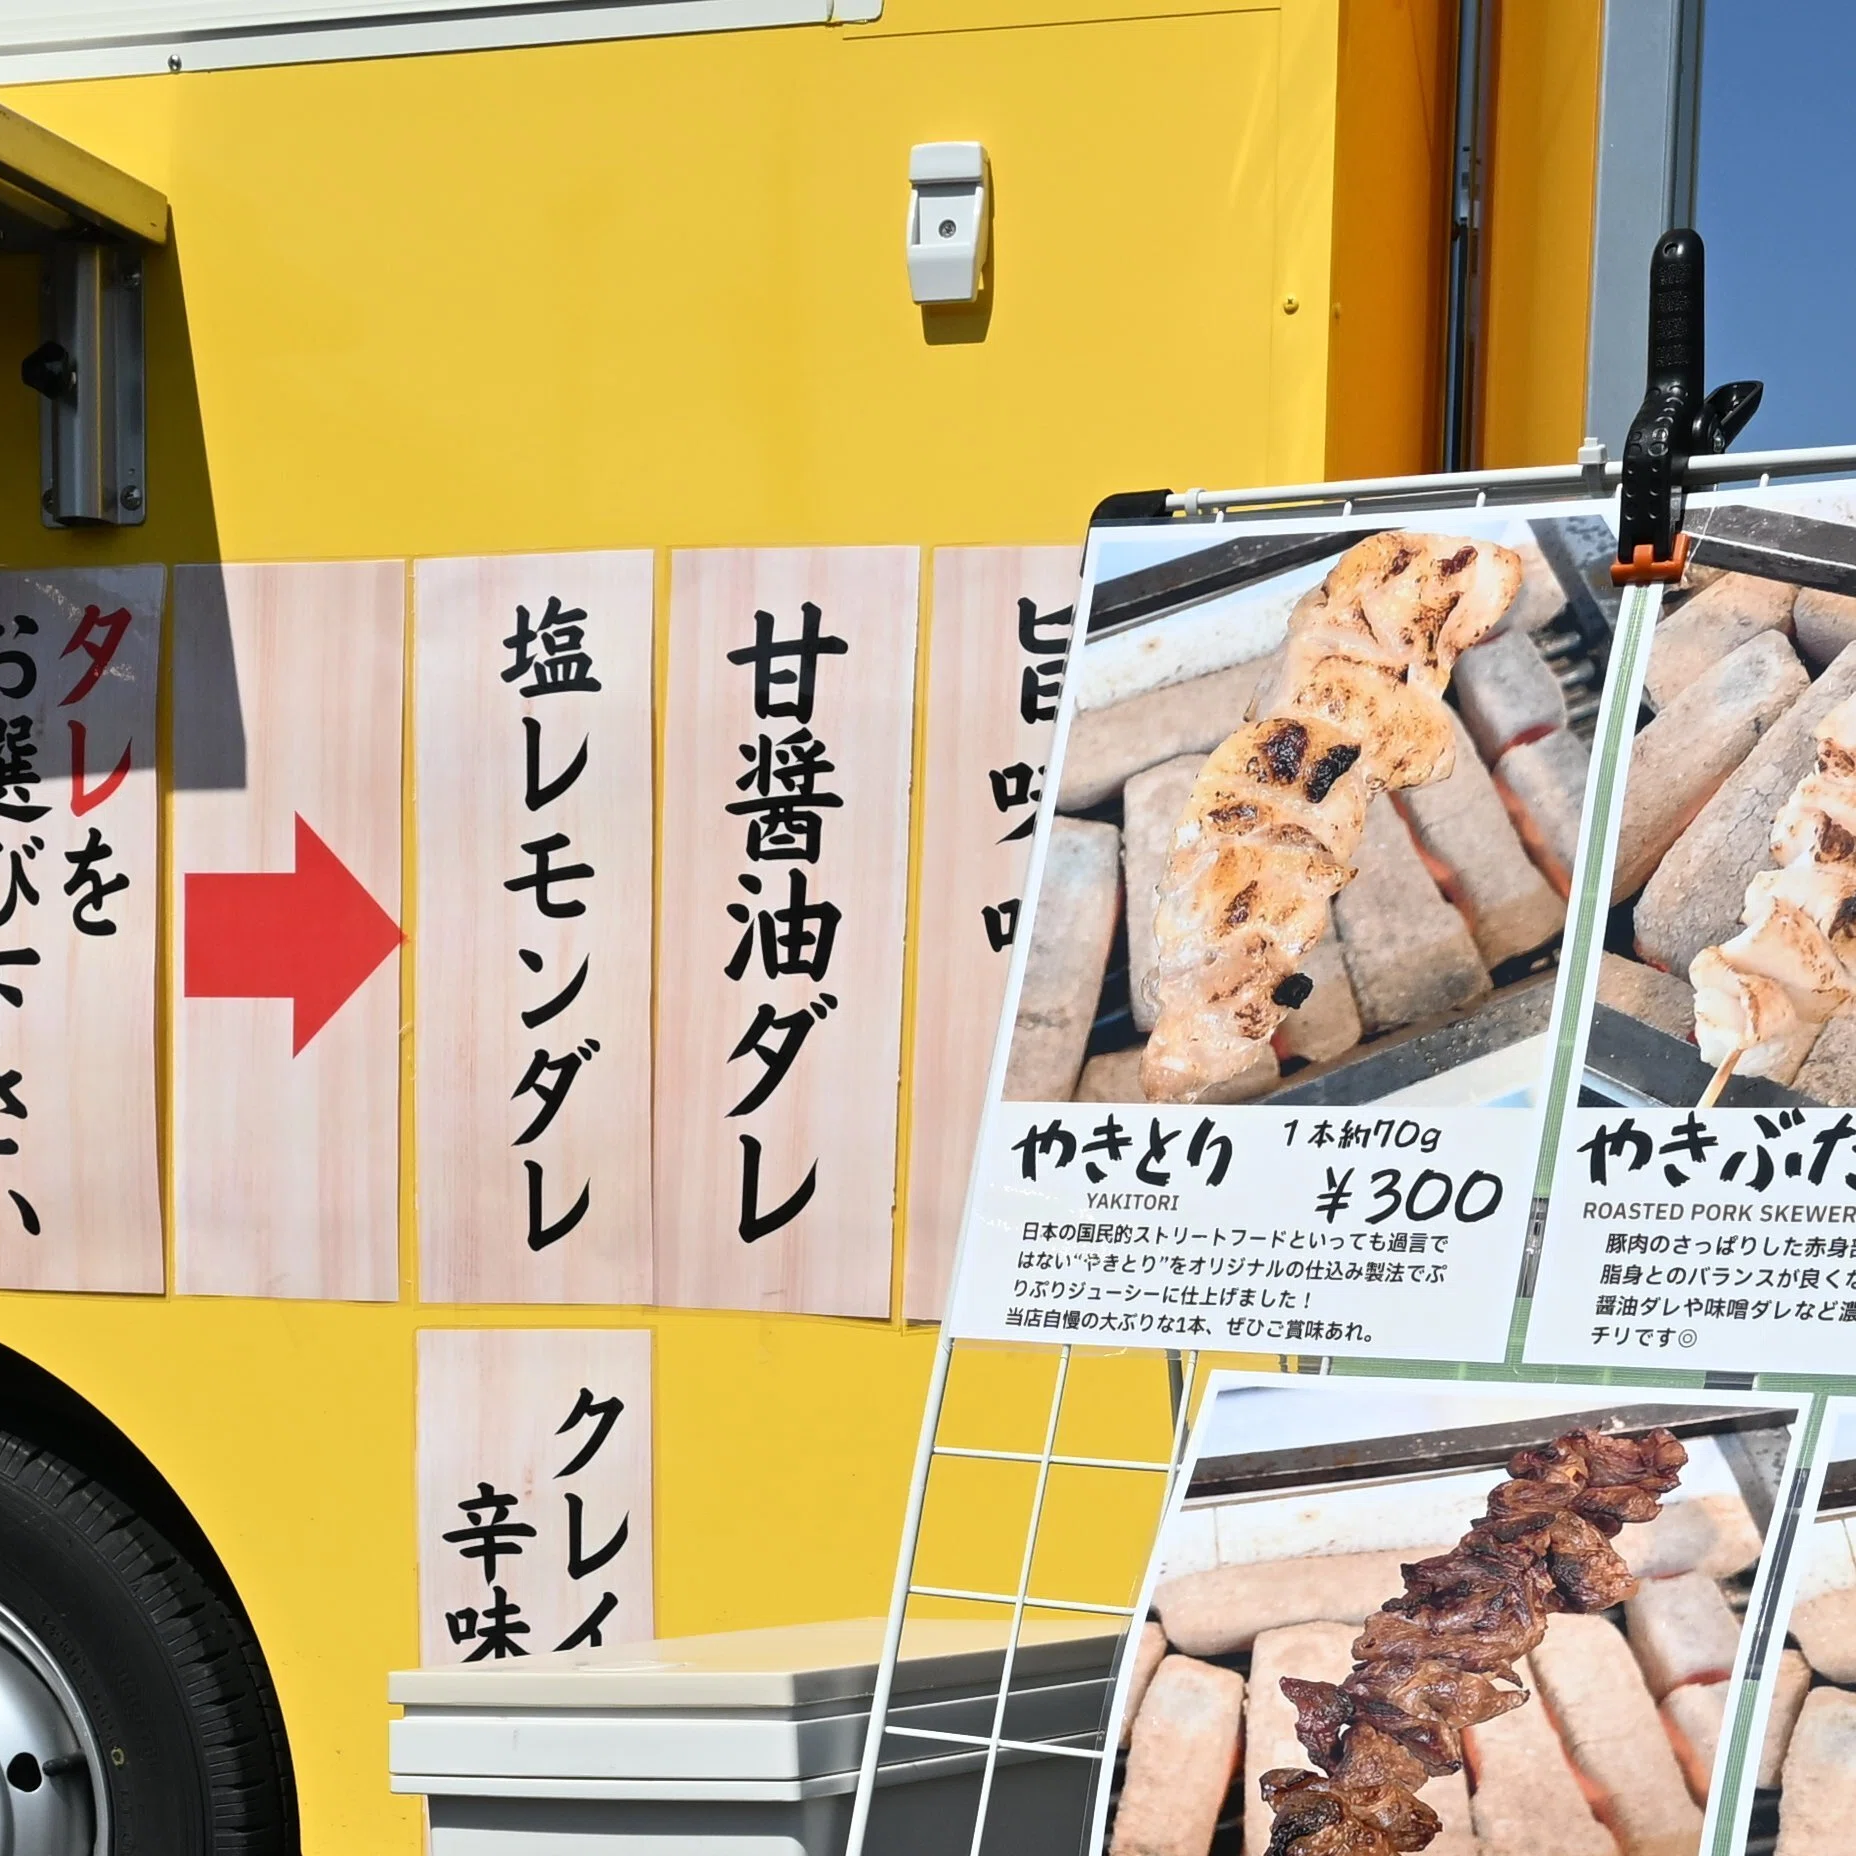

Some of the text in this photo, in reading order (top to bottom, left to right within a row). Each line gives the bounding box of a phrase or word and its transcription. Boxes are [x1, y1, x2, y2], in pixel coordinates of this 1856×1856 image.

[55, 602, 142, 937] タレを
[500, 595, 603, 1253] 塩レモンダレ
[723, 600, 849, 1244] 甘醤油ダレ
[1010, 1112, 1233, 1188] やきとり
[1283, 1118, 1442, 1154] 1本約70g
[1087, 1192, 1180, 1211] YAKITORI
[1314, 1165, 1504, 1226] ¥300
[1582, 1201, 1685, 1221] ROASTED
[1690, 1203, 1754, 1222] PORK
[1022, 1221, 1449, 1254] 日本の国民的ストリートフードといっても過言で
[442, 1482, 537, 1663] 辛味
